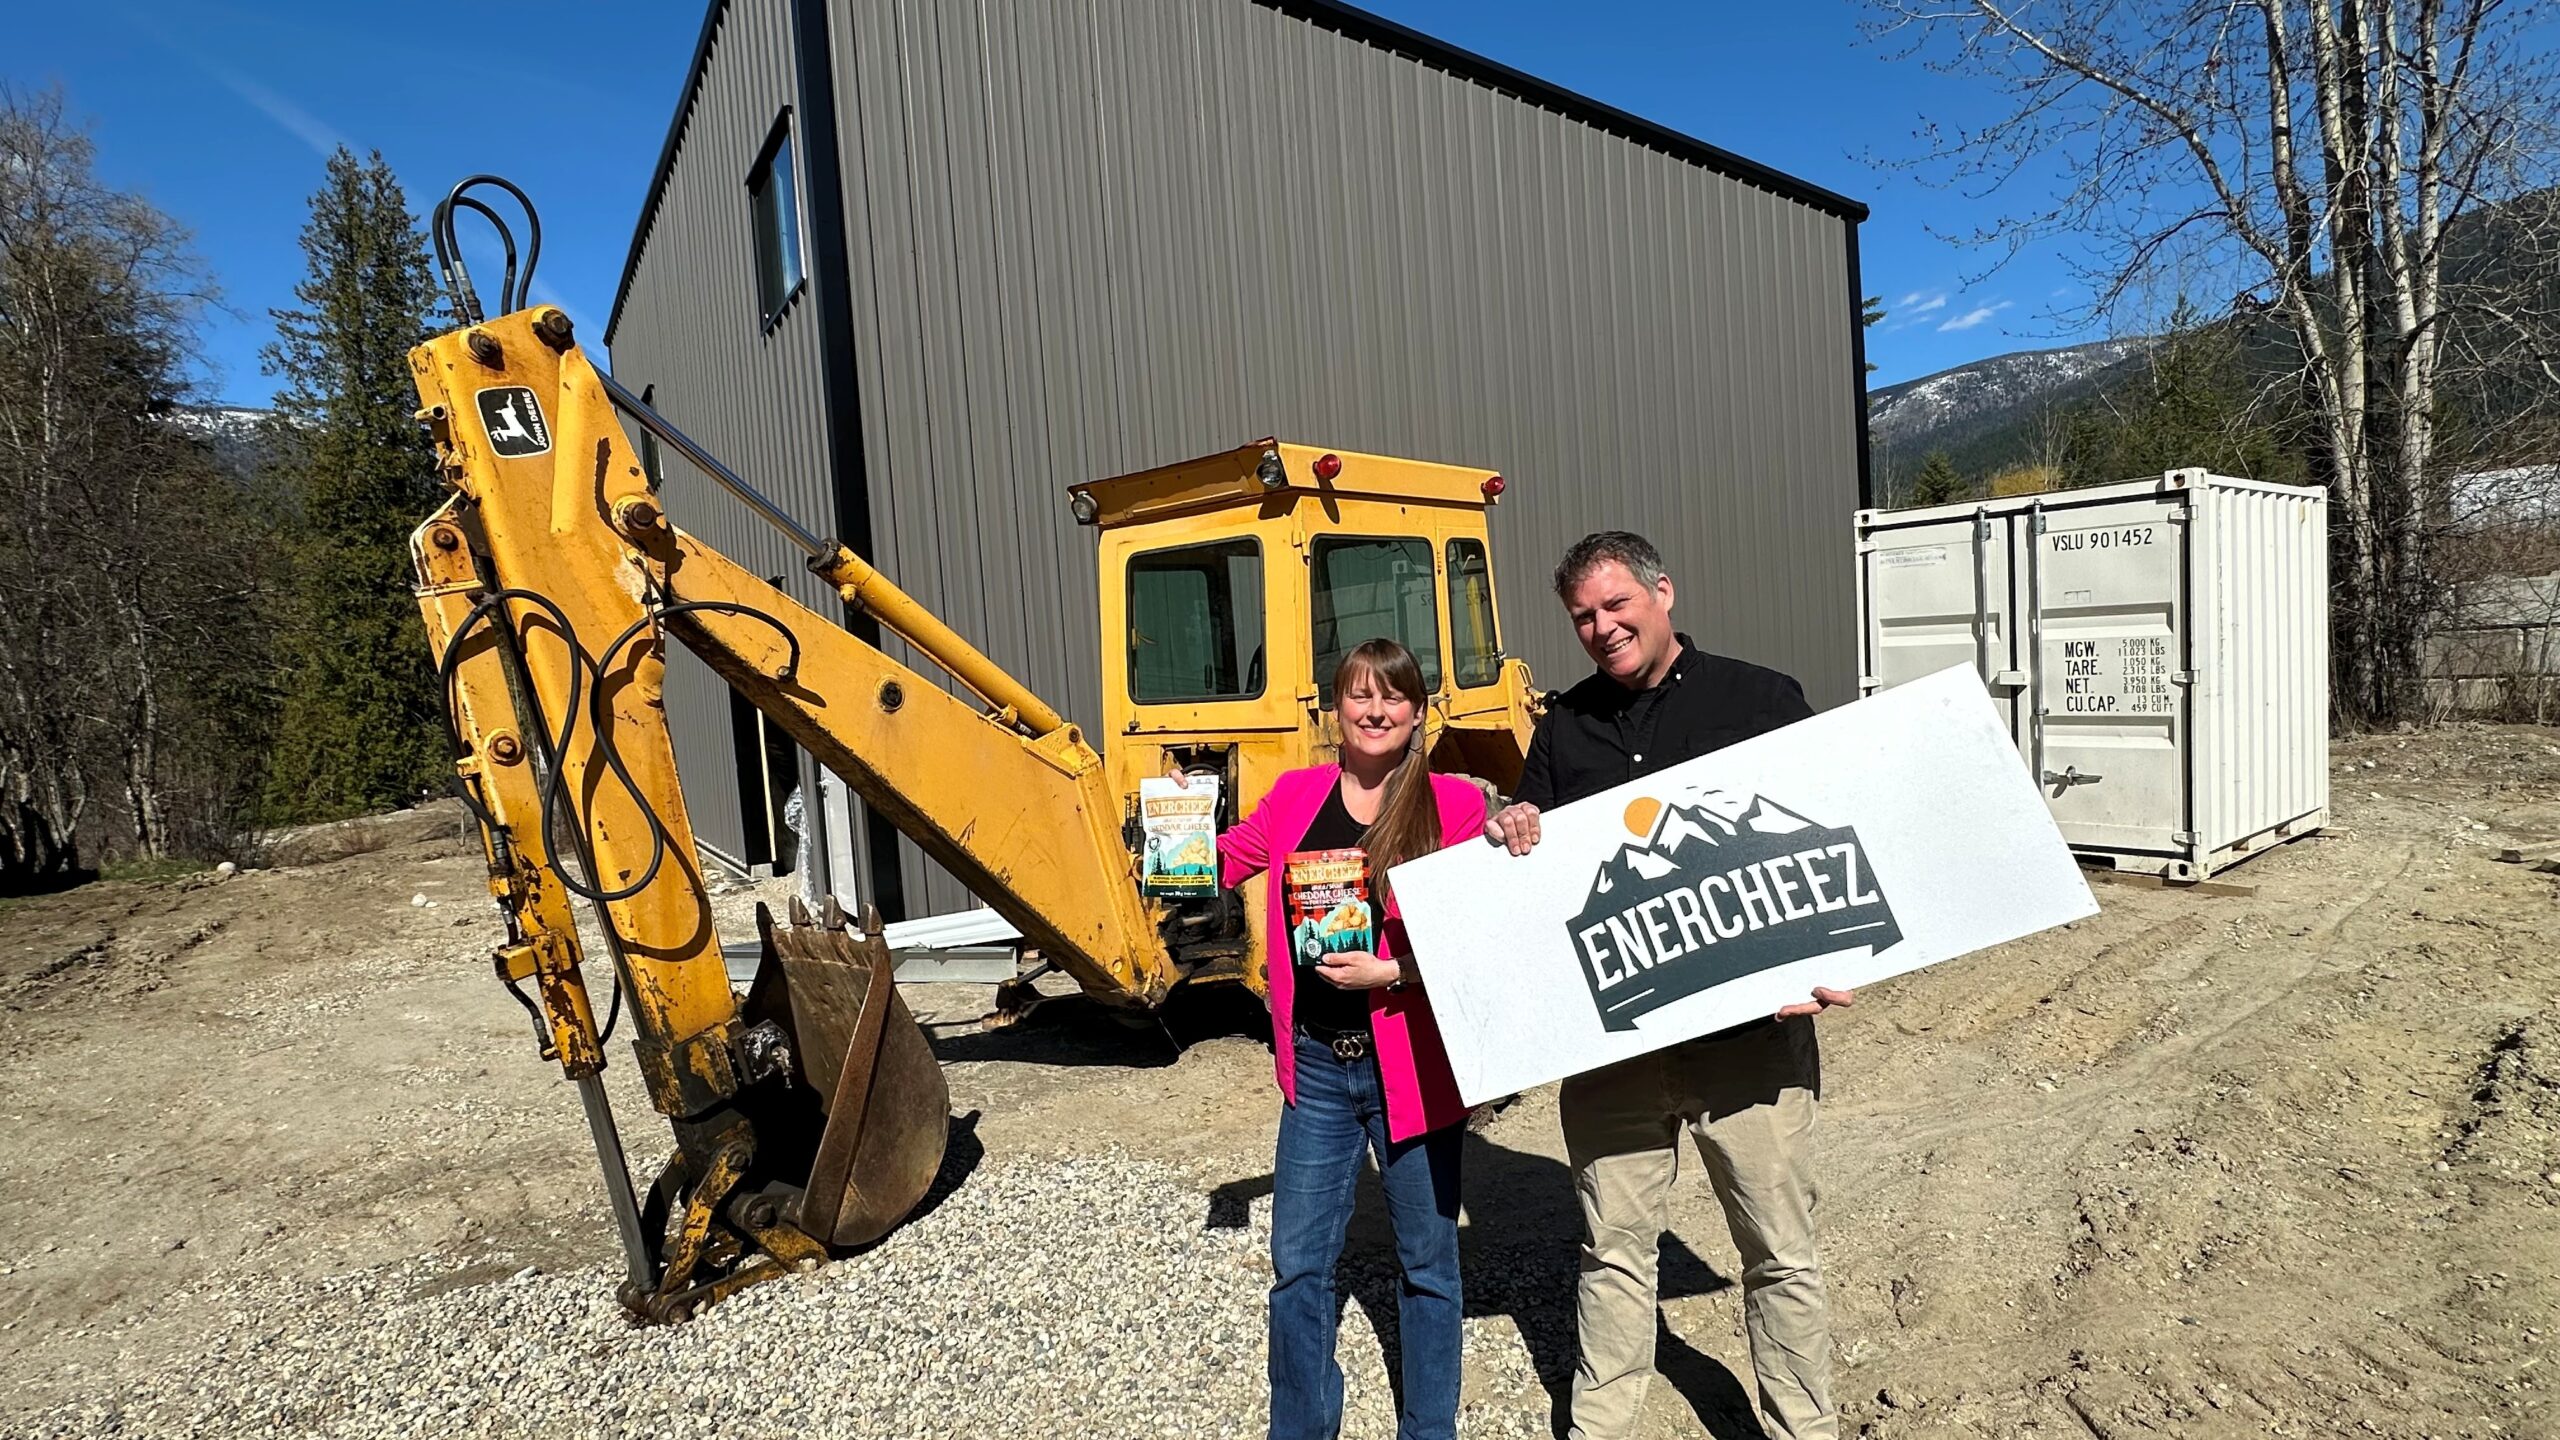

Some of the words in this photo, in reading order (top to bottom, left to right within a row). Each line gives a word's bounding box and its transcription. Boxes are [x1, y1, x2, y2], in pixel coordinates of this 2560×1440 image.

[522, 391, 539, 422] DEERE
[532, 423, 547, 448] JOHN
[2052, 534, 2084, 551] VSLU
[2090, 528, 2153, 550] 901452
[2065, 641, 2099, 658] MGW.
[2150, 637, 2160, 647] KG
[2150, 646, 2166, 656] LBS
[2065, 659, 2102, 676] TARE.
[2150, 656, 2160, 666] KG
[2150, 665, 2166, 675] LBS
[2065, 677, 2094, 694] NET.
[2151, 675, 2161, 685] KG
[2151, 684, 2167, 694] LBS
[2137, 694, 2147, 704] 13
[2131, 703, 2147, 713] 459
[1146, 799, 1213, 818] ENERCHEEZ
[1291, 864, 1363, 883] ENERCHEEZ
[1293, 889, 1331, 900] CHEDDAR
[1332, 887, 1361, 899] CHEESE
[1578, 842, 1880, 992] ENERCHEEZ
